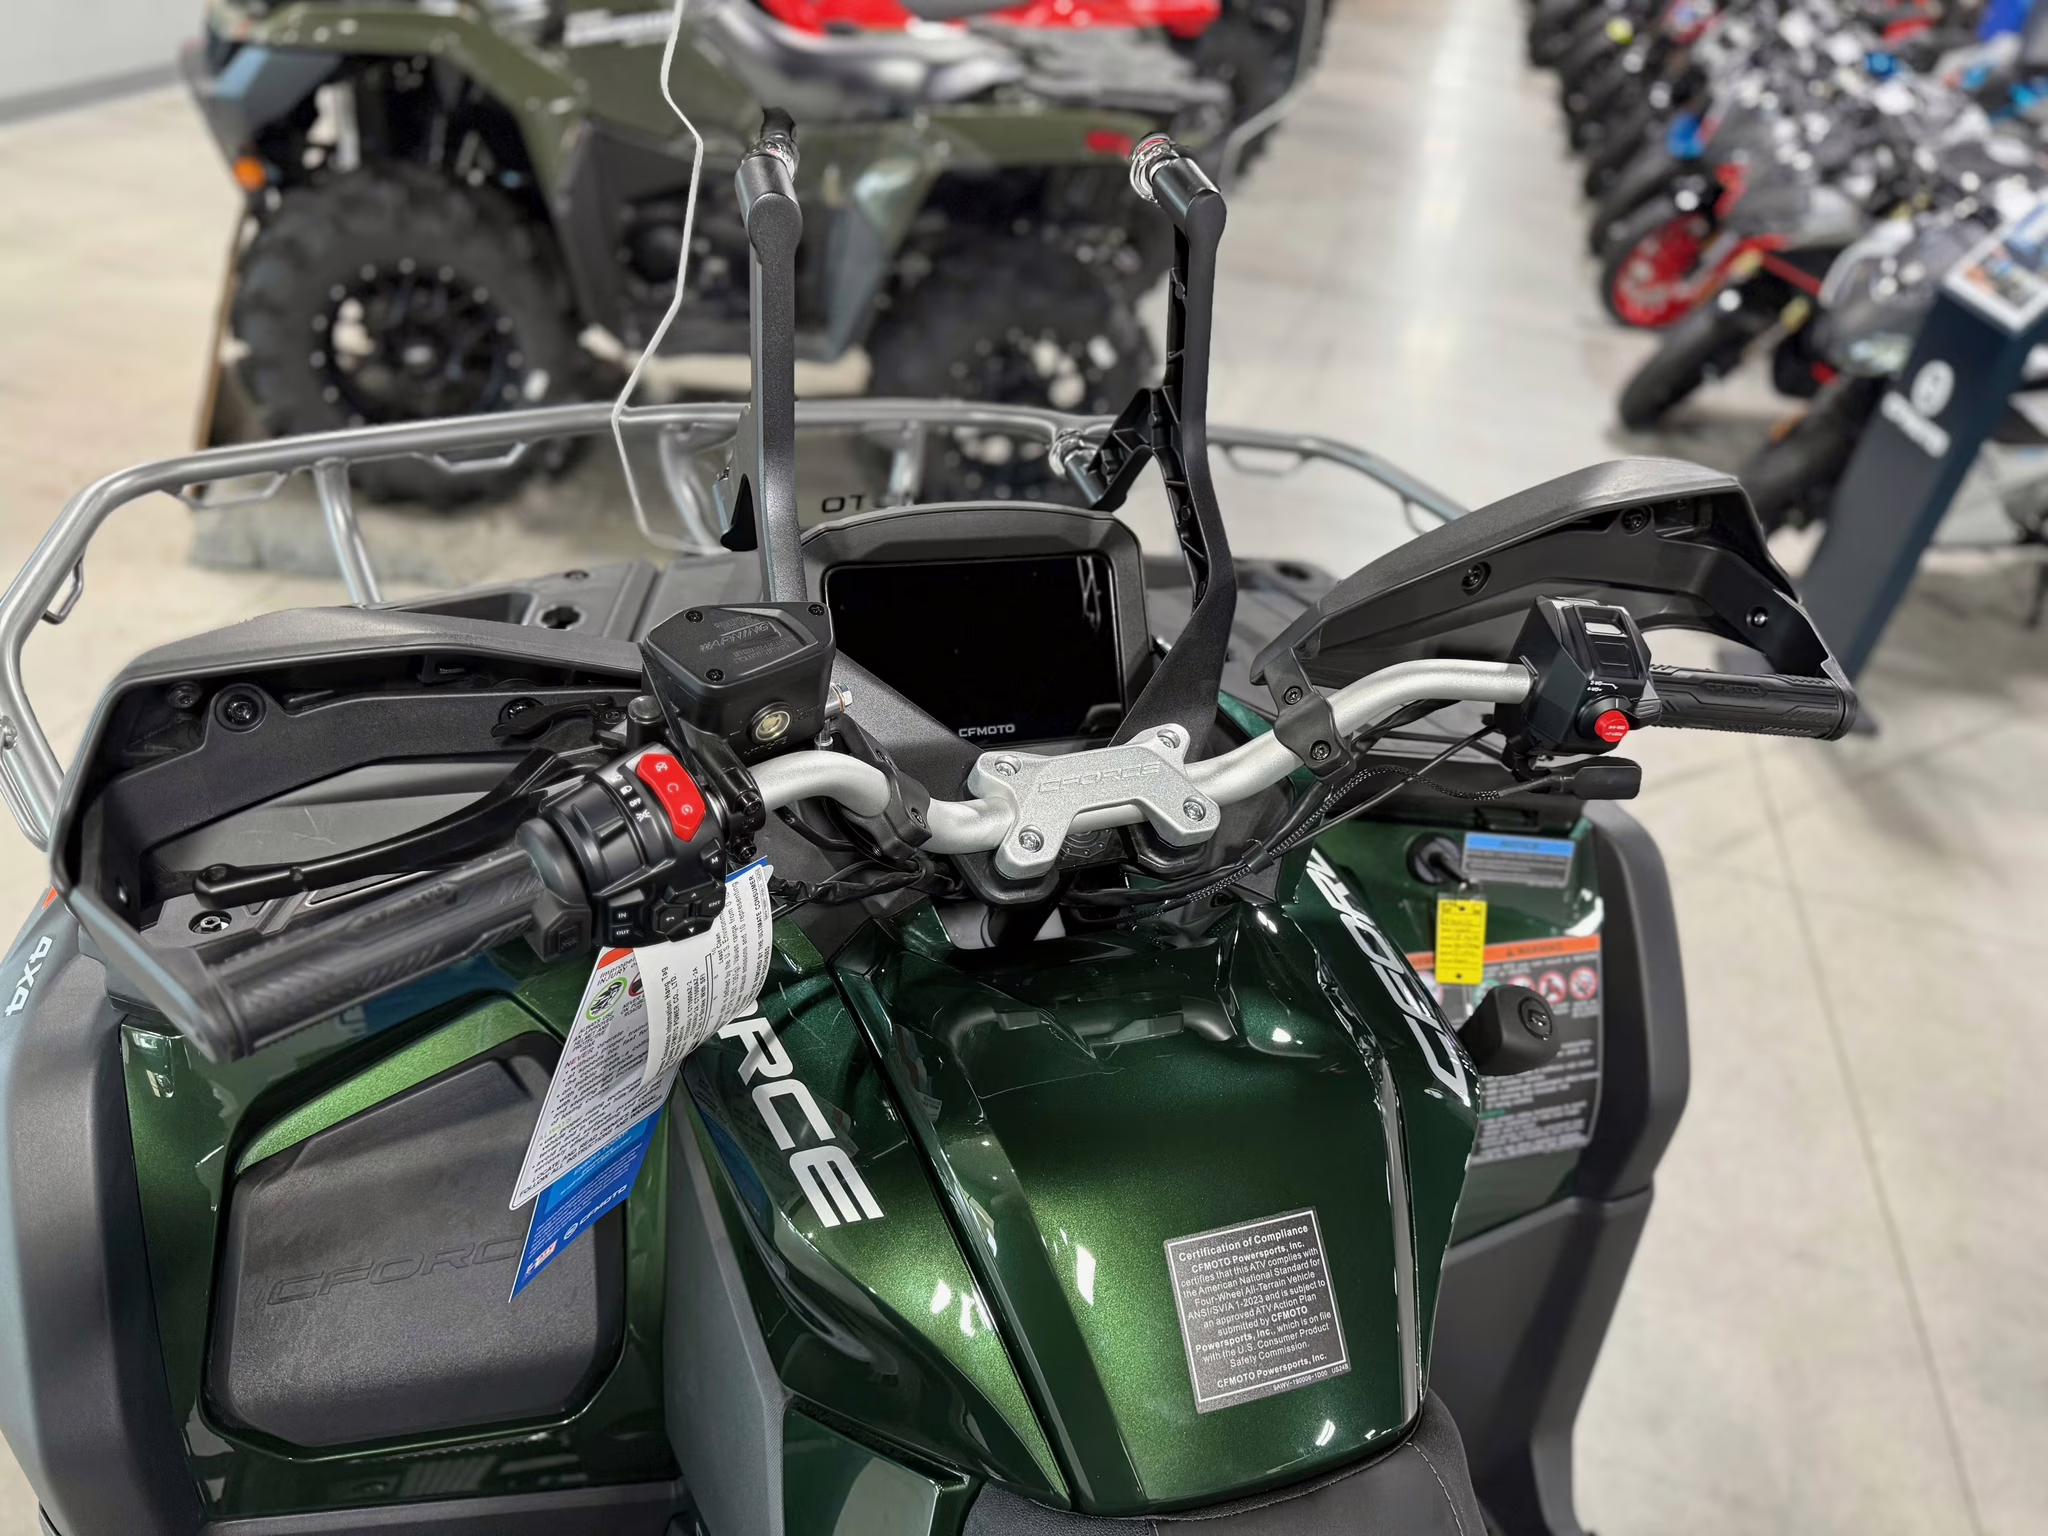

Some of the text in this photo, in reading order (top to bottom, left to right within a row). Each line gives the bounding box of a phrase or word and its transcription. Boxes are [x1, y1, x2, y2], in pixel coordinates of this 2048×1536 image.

[958, 724, 1015, 737] CFMOTO
[1037, 763, 1162, 793] CFORCE
[629, 798, 641, 808] OFF
[711, 856, 719, 864] M
[709, 899, 720, 908] ENT
[732, 880, 745, 923] representing
[749, 874, 761, 910] CONSUMER
[617, 911, 627, 919] IN
[740, 923, 746, 933] 10
[663, 981, 671, 1001] Hang
[718, 1001, 885, 1229] RCE
[1178, 1223, 1308, 1262] Certification of Compliance
[1191, 1239, 1304, 1273] CFMOTO Powersports, Inc.
[267, 1234, 523, 1306] CFORC
[1180, 1246, 1318, 1287] certifies that this ATV complies with
[1183, 1257, 1320, 1298] the American National Standard for
[1187, 1279, 1325, 1320] ANSI/SVIA 1-2023 and is subject to
[1194, 1270, 1315, 1307] Four-Wheel All-Terrain Vehicle
[1202, 1292, 1317, 1328] an approved ATV Action Plan
[1217, 1305, 1308, 1336] submitted by CFMOTO
[1195, 1311, 1331, 1353] Powersports, Inc., which is on file
[1202, 1322, 1329, 1363] with the U.S. Consumer Product
[1216, 1352, 1327, 1388] CFMOTO Powersports, Inc.
[1229, 1340, 1310, 1368] Safety Commission.
